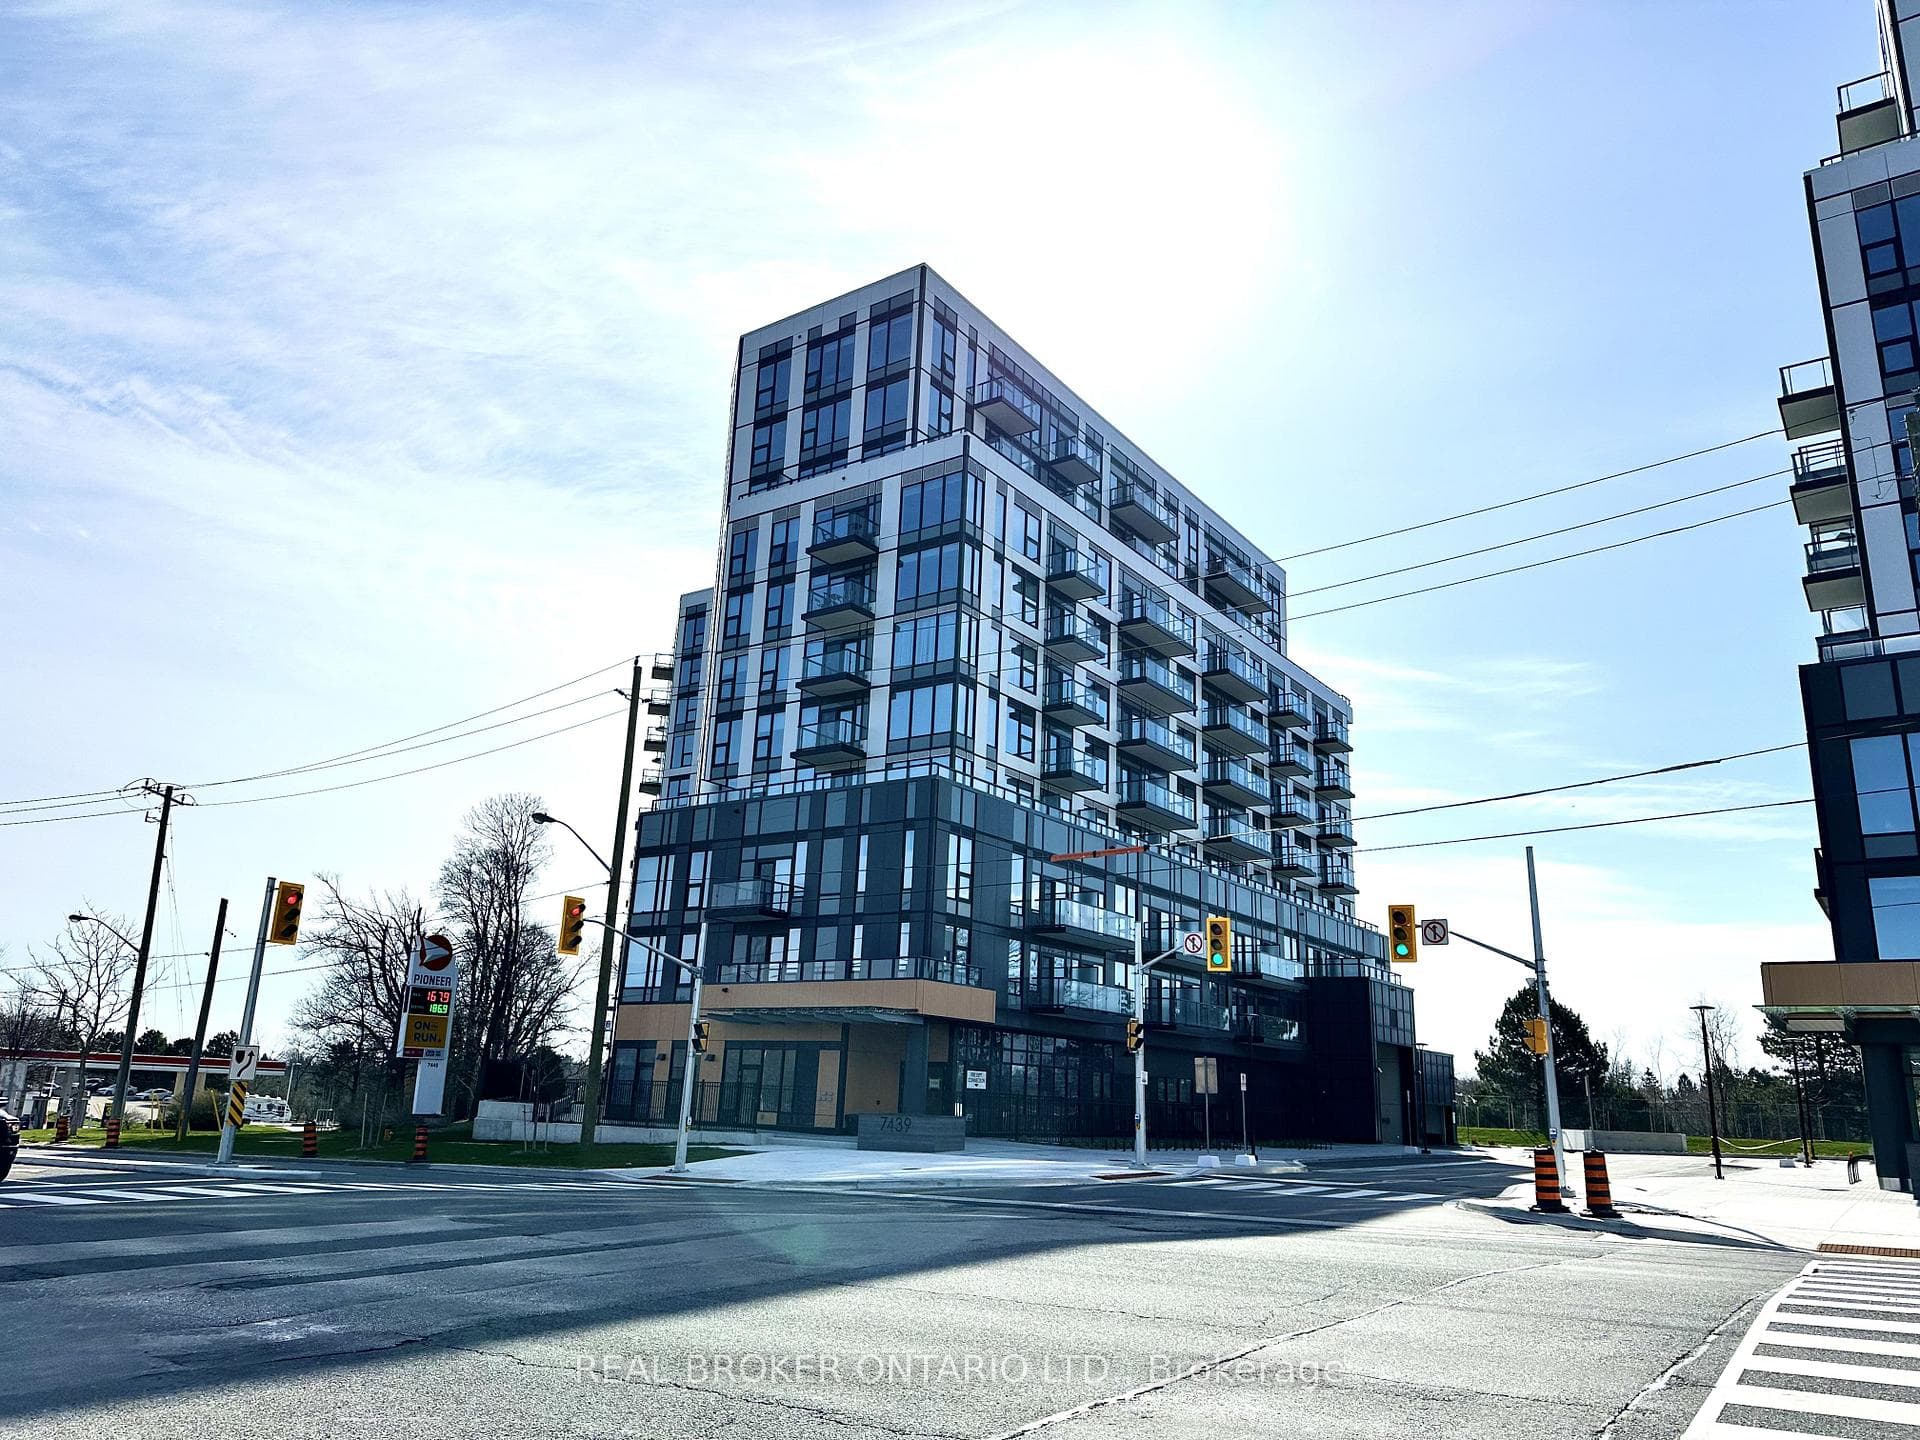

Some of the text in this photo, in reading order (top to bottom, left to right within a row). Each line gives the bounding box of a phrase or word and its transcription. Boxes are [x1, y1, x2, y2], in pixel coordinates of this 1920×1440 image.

[414, 974, 451, 986] PIONEER
[414, 1021, 431, 1030] ON
[879, 1116, 912, 1133] 7439
